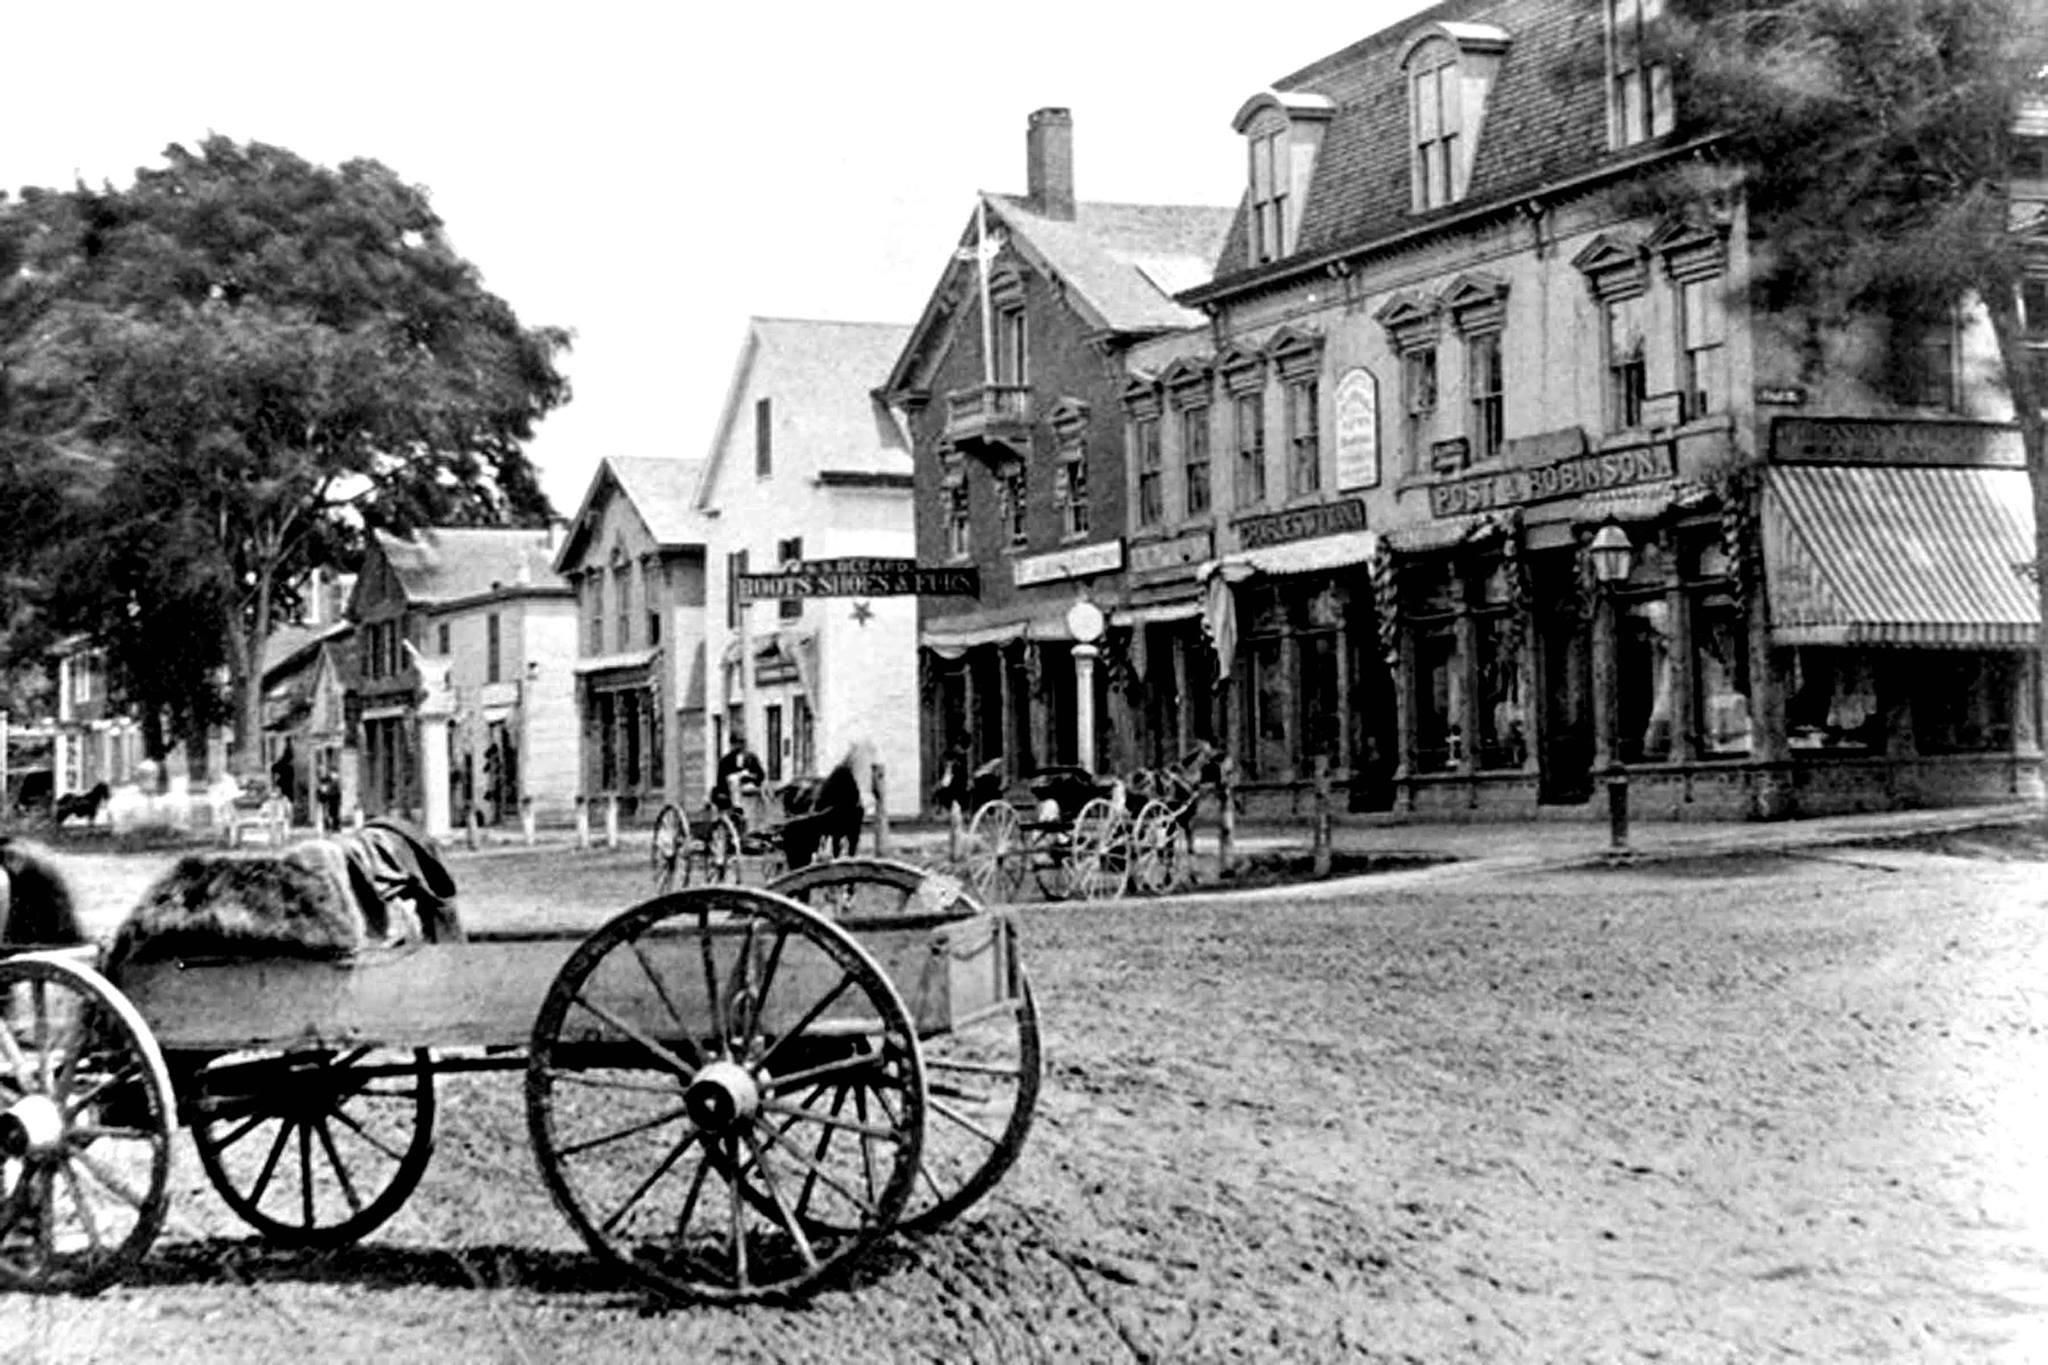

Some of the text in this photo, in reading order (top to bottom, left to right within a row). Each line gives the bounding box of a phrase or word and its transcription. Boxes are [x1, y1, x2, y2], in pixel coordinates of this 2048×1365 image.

[1435, 478, 1496, 515] POST
[738, 576, 812, 596] BOOTS
[817, 575, 890, 595] SHOES
[895, 574, 909, 593] &
